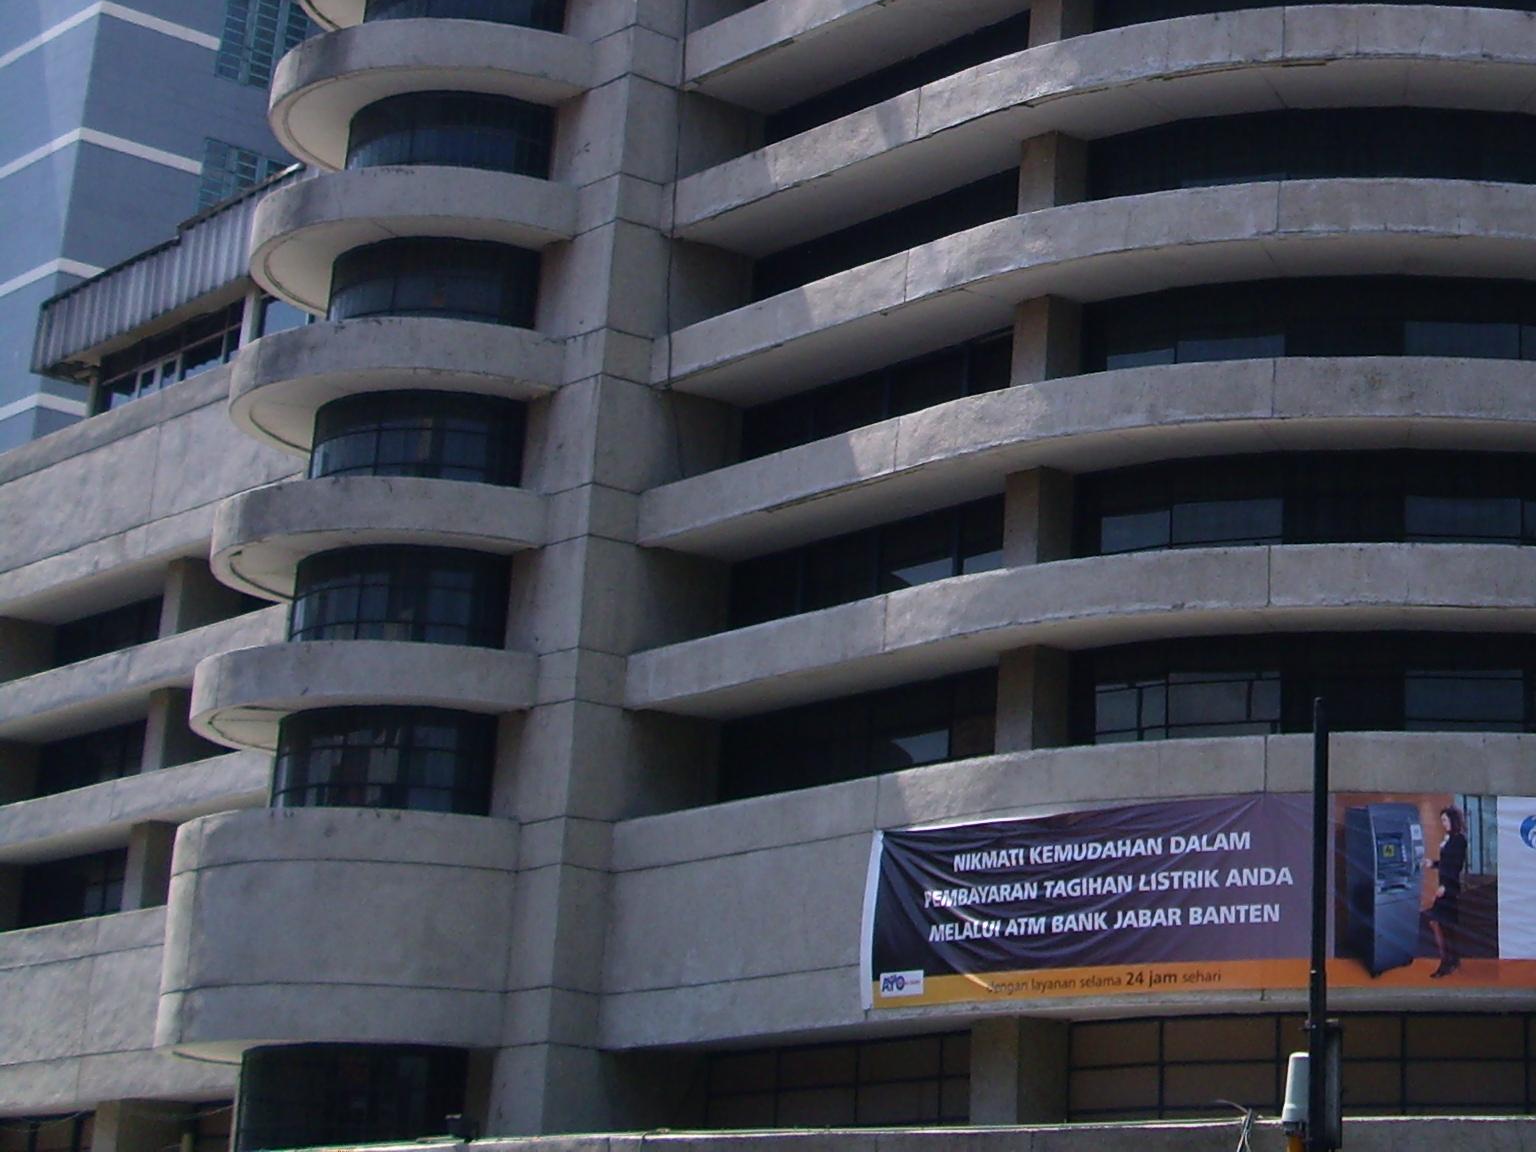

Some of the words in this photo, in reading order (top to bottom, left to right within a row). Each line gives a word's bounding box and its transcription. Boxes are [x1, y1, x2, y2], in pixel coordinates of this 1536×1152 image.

[953, 848, 1024, 872] NIKMATI
[1029, 836, 1163, 865] KEMUDAHAN
[1169, 831, 1251, 854] DALAM
[924, 881, 1038, 908] PEMBAYARAN
[1043, 875, 1133, 898] TAGIHAN
[1138, 868, 1220, 892] LISTRIK
[1225, 866, 1294, 887] ANDA
[929, 919, 1001, 943] MELALUI
[1004, 916, 1046, 937] ATM
[1051, 911, 1109, 933] BANK
[1113, 907, 1183, 929] JABAR
[1188, 903, 1280, 926] BANTEN
[1031, 977, 1076, 992] layanan
[1079, 975, 1122, 988] selama
[1125, 971, 1144, 986] 24
[1148, 969, 1177, 988] jam
[1182, 969, 1222, 983] sehari
